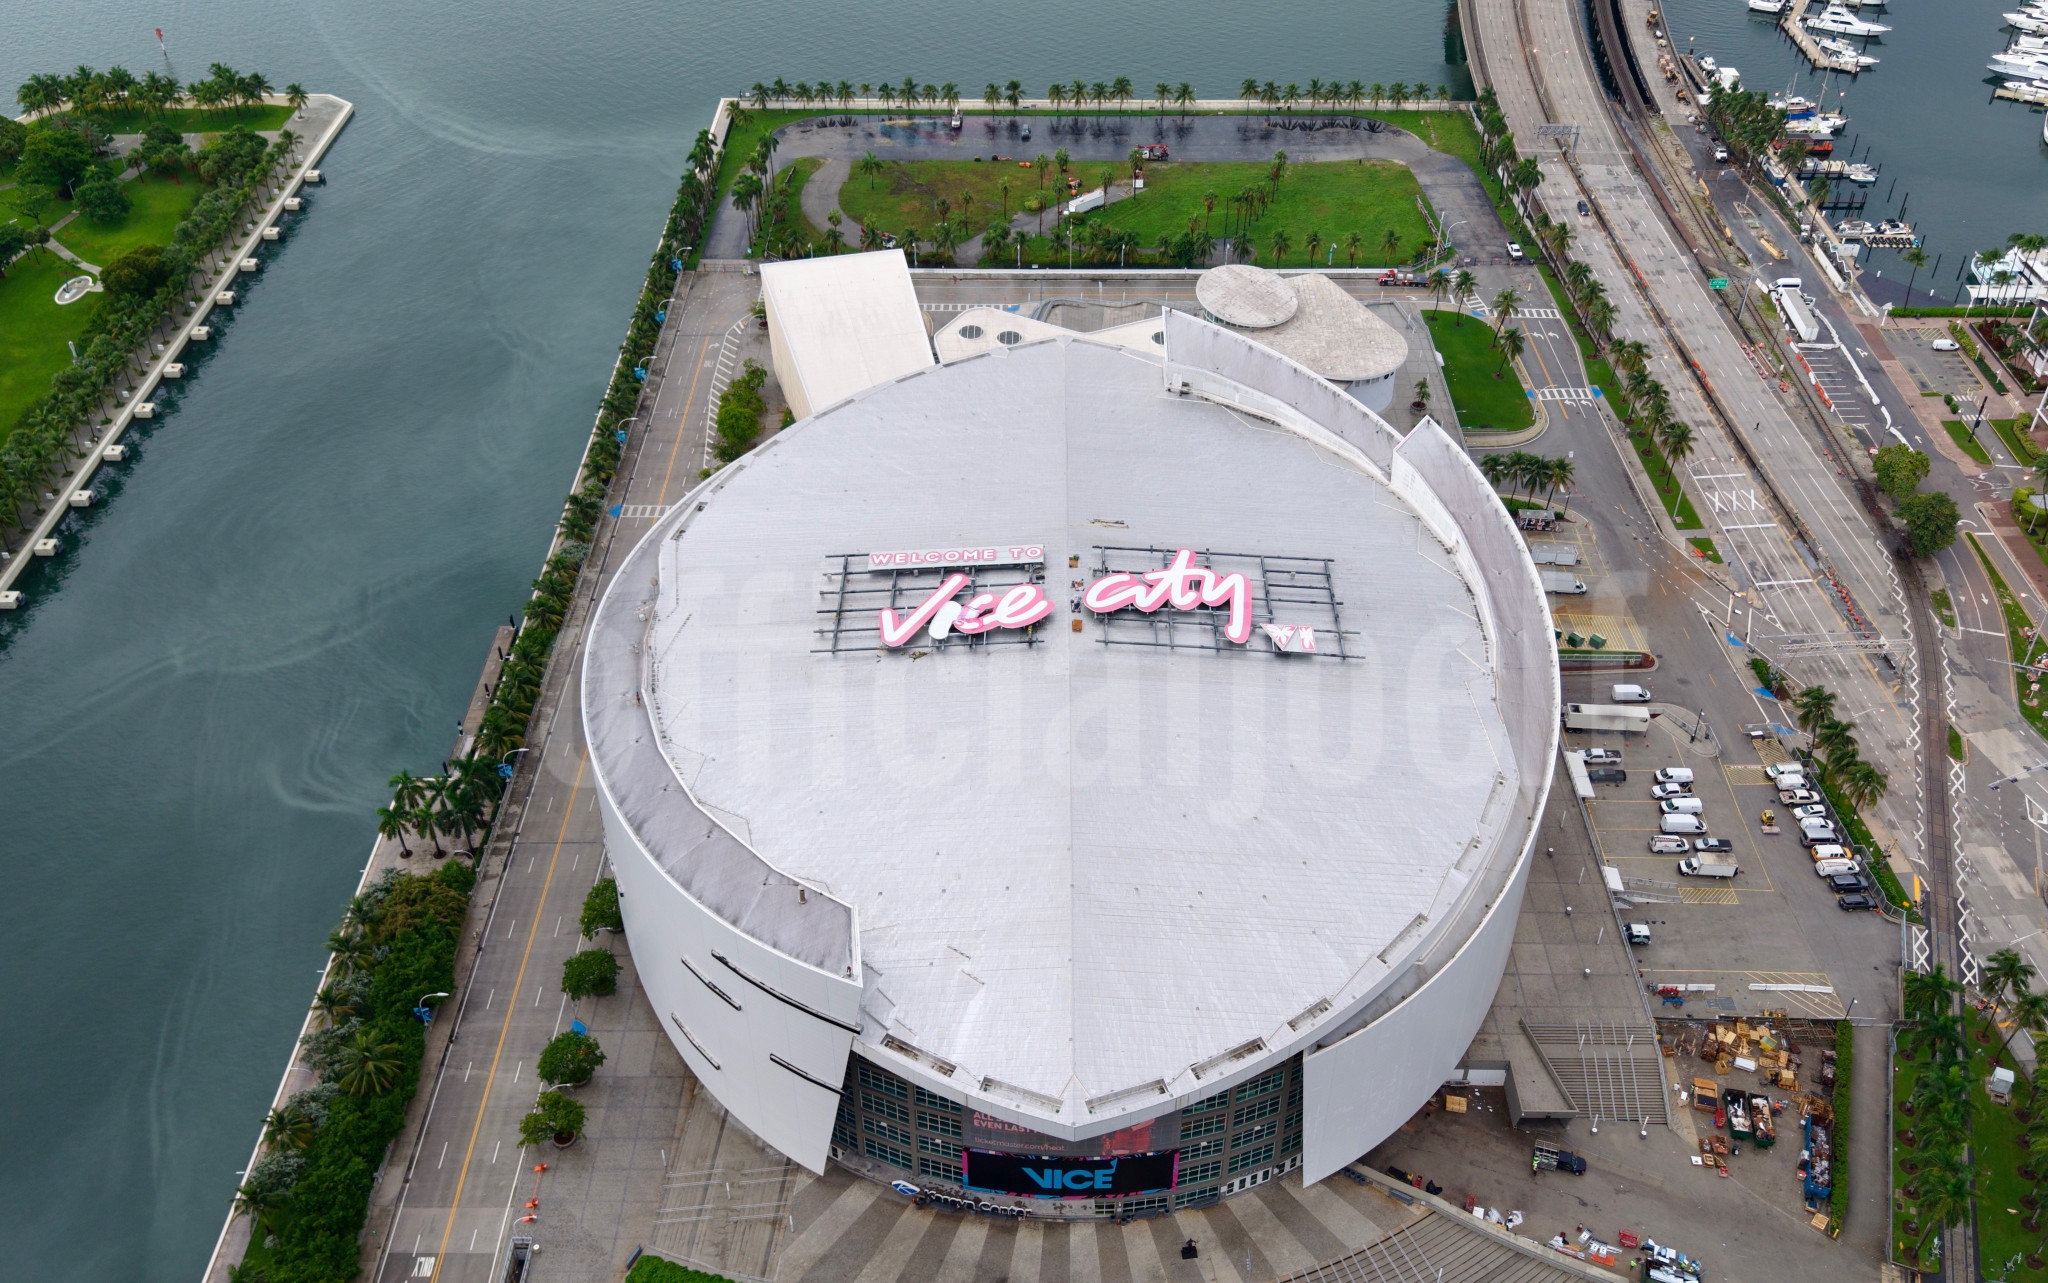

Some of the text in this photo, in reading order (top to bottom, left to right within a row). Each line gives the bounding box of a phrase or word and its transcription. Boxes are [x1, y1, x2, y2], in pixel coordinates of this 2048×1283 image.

[871, 546, 1043, 566] WELCOME TO
[973, 1119, 1002, 1129] EVEN
[974, 1137, 1065, 1151] ticketmaster.com/heat
[1022, 1158, 1118, 1190] VICE
[979, 1201, 1032, 1218] Center
[411, 1256, 436, 1277] ONLY
